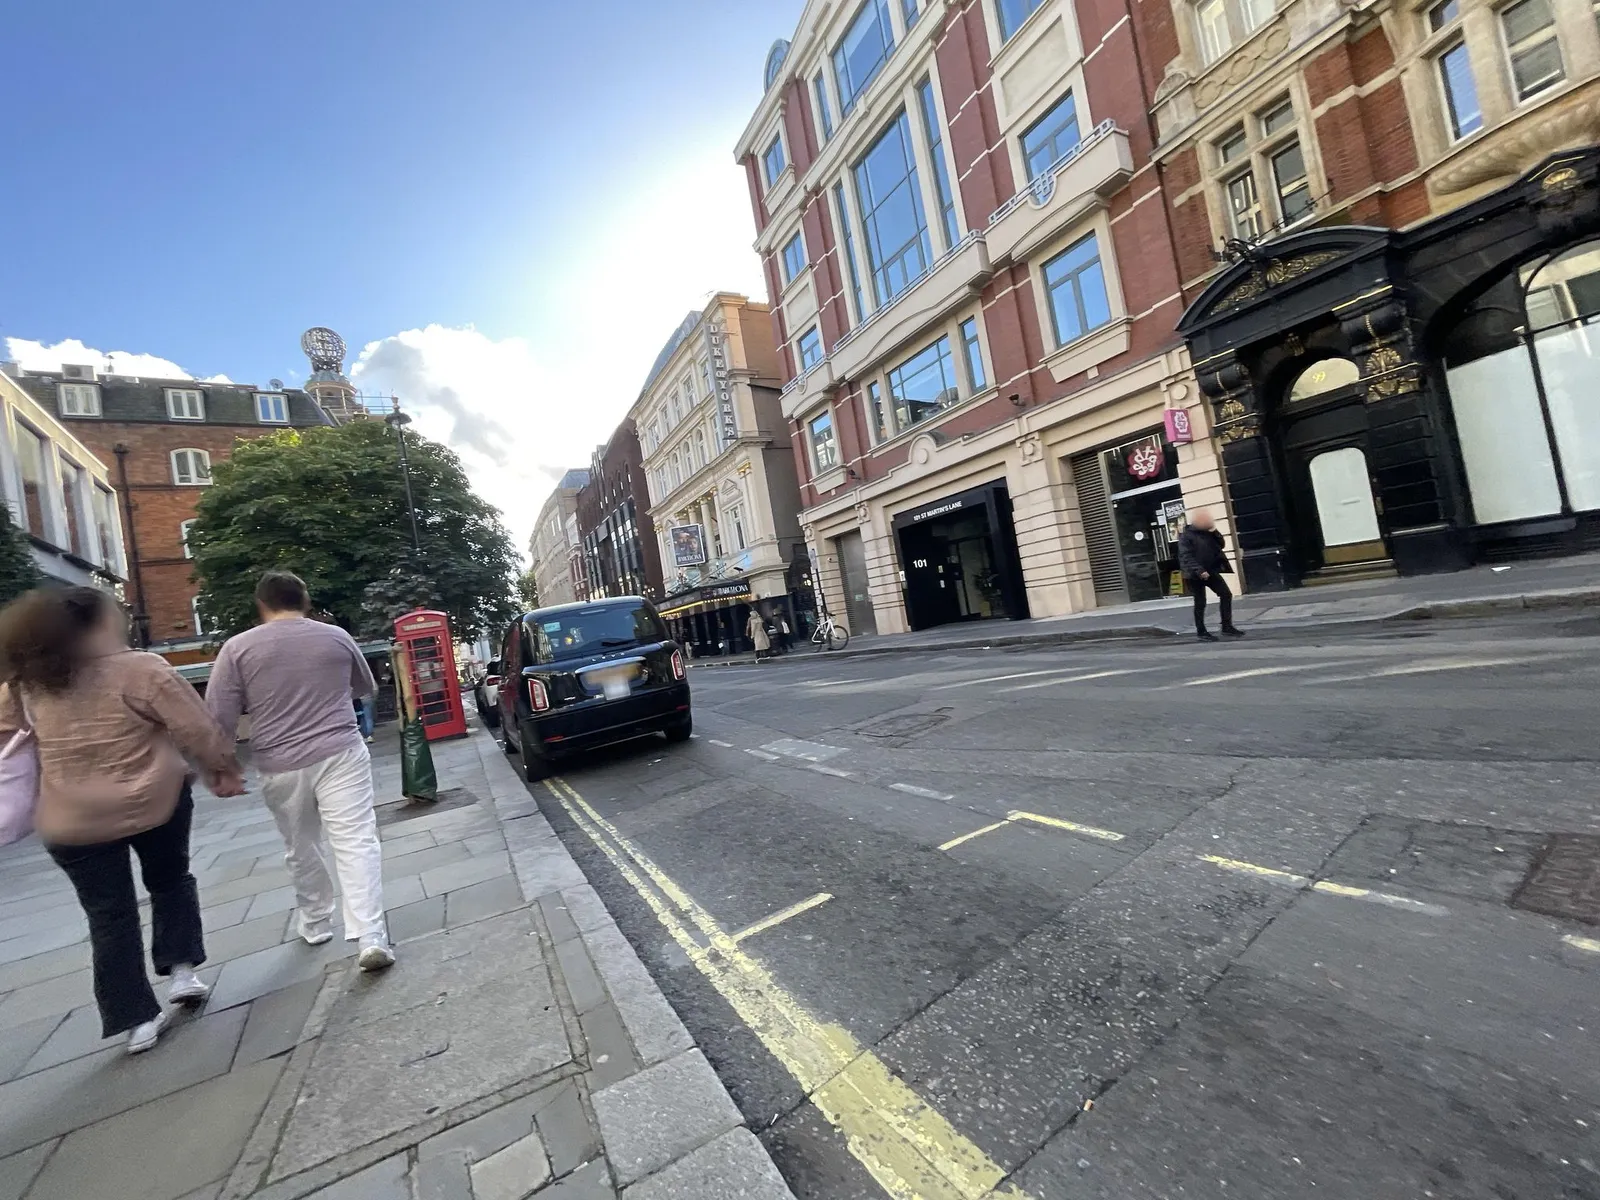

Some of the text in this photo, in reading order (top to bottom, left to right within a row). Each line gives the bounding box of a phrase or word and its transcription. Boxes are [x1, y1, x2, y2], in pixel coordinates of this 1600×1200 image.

[710, 325, 735, 437] DUKE OF YORK'S
[1312, 370, 1326, 384] 99
[927, 505, 948, 516] MARTIN'S
[949, 501, 962, 510] LANE
[913, 559, 927, 568] 101
